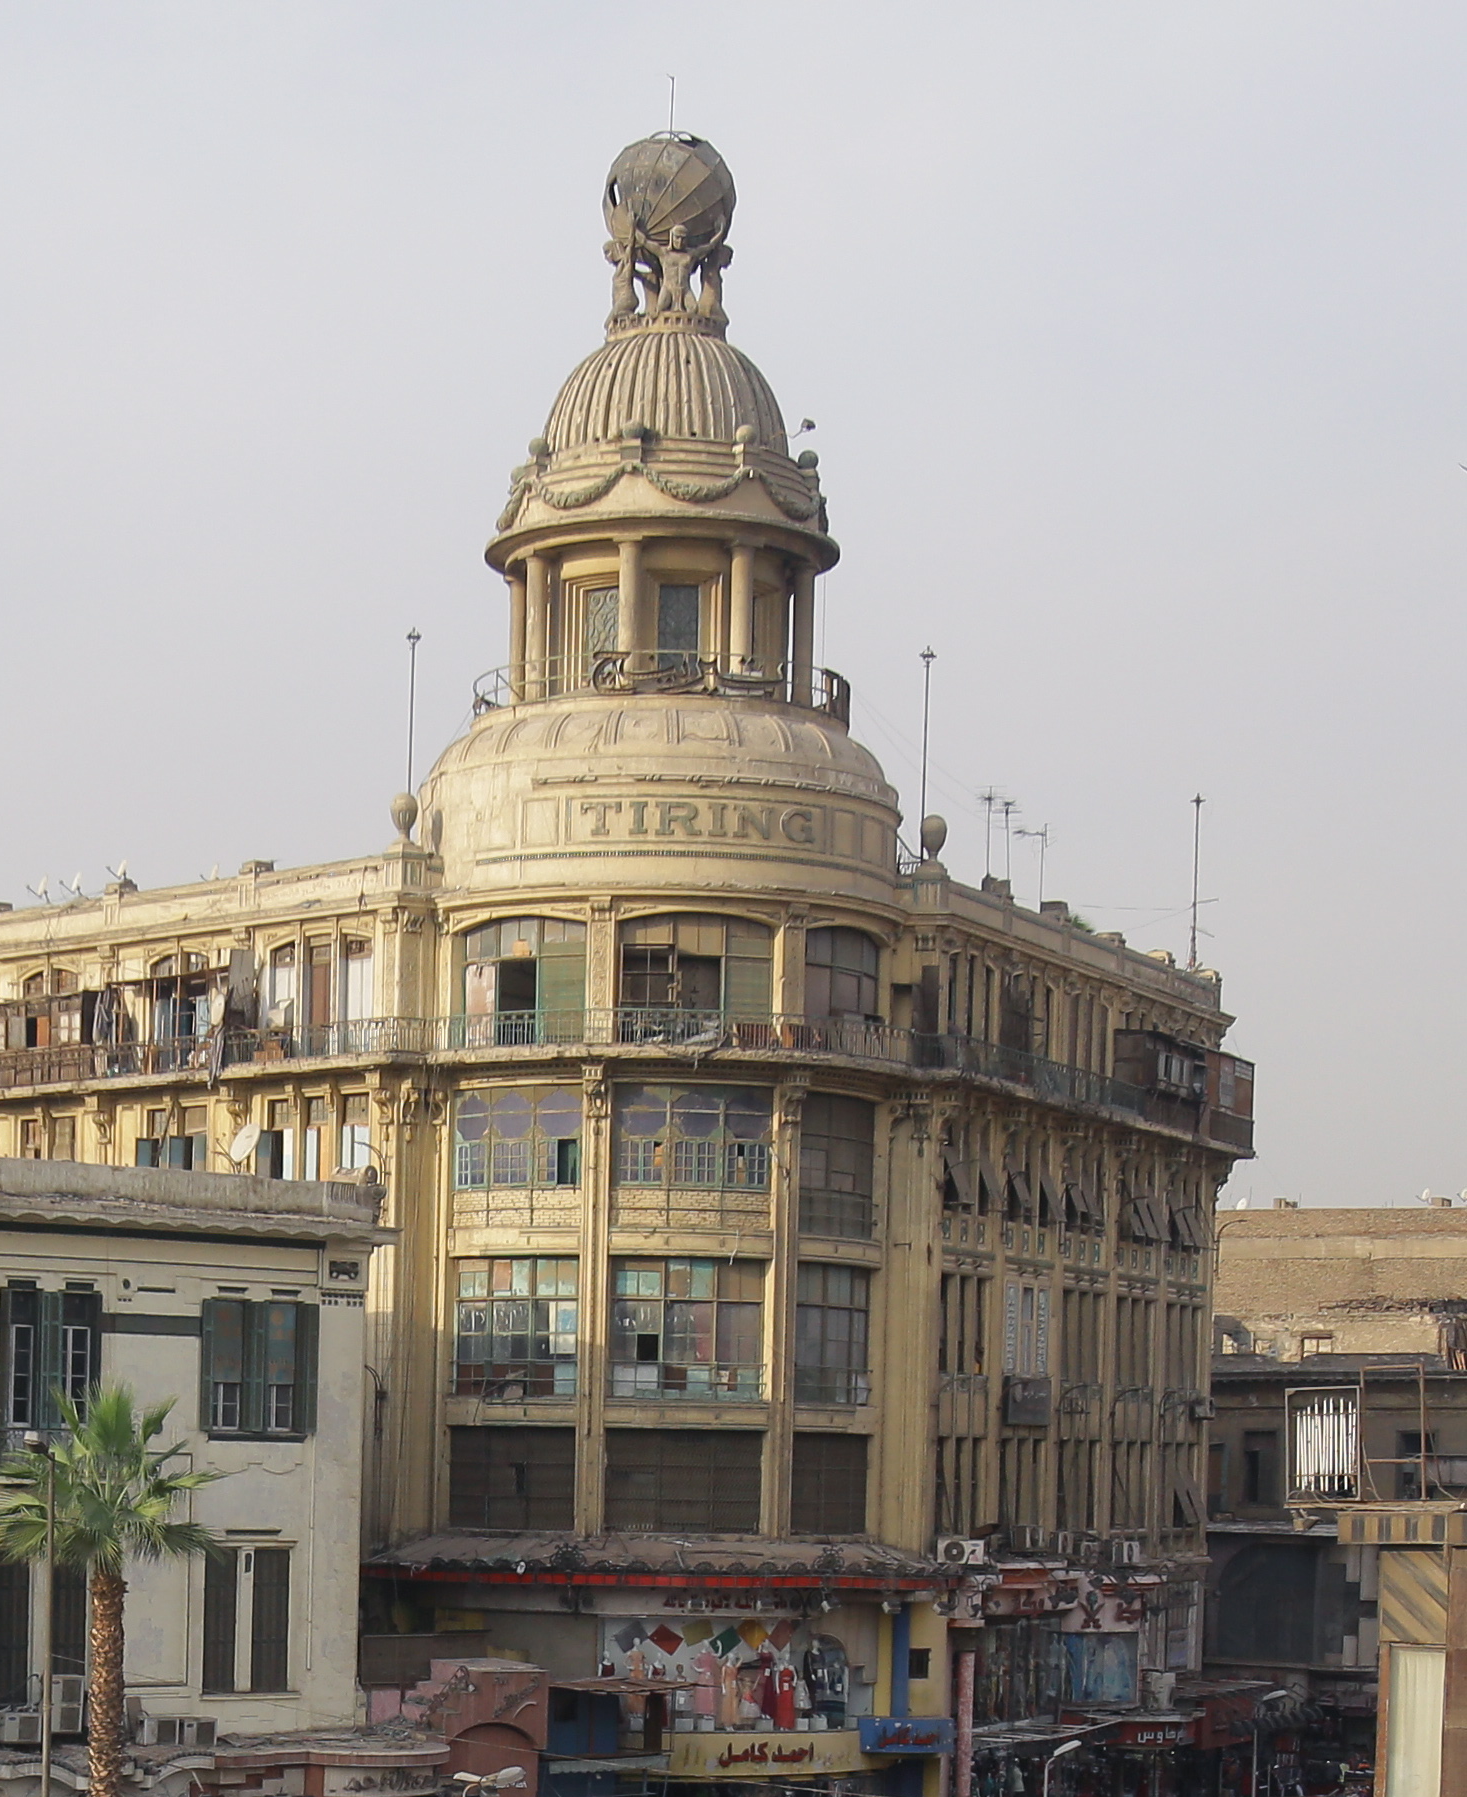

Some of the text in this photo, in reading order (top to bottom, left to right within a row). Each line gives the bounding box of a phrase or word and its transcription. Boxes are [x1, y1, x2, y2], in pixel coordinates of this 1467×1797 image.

[580, 799, 816, 844] TIRING
[718, 1741, 814, 1767] احمد كامل
